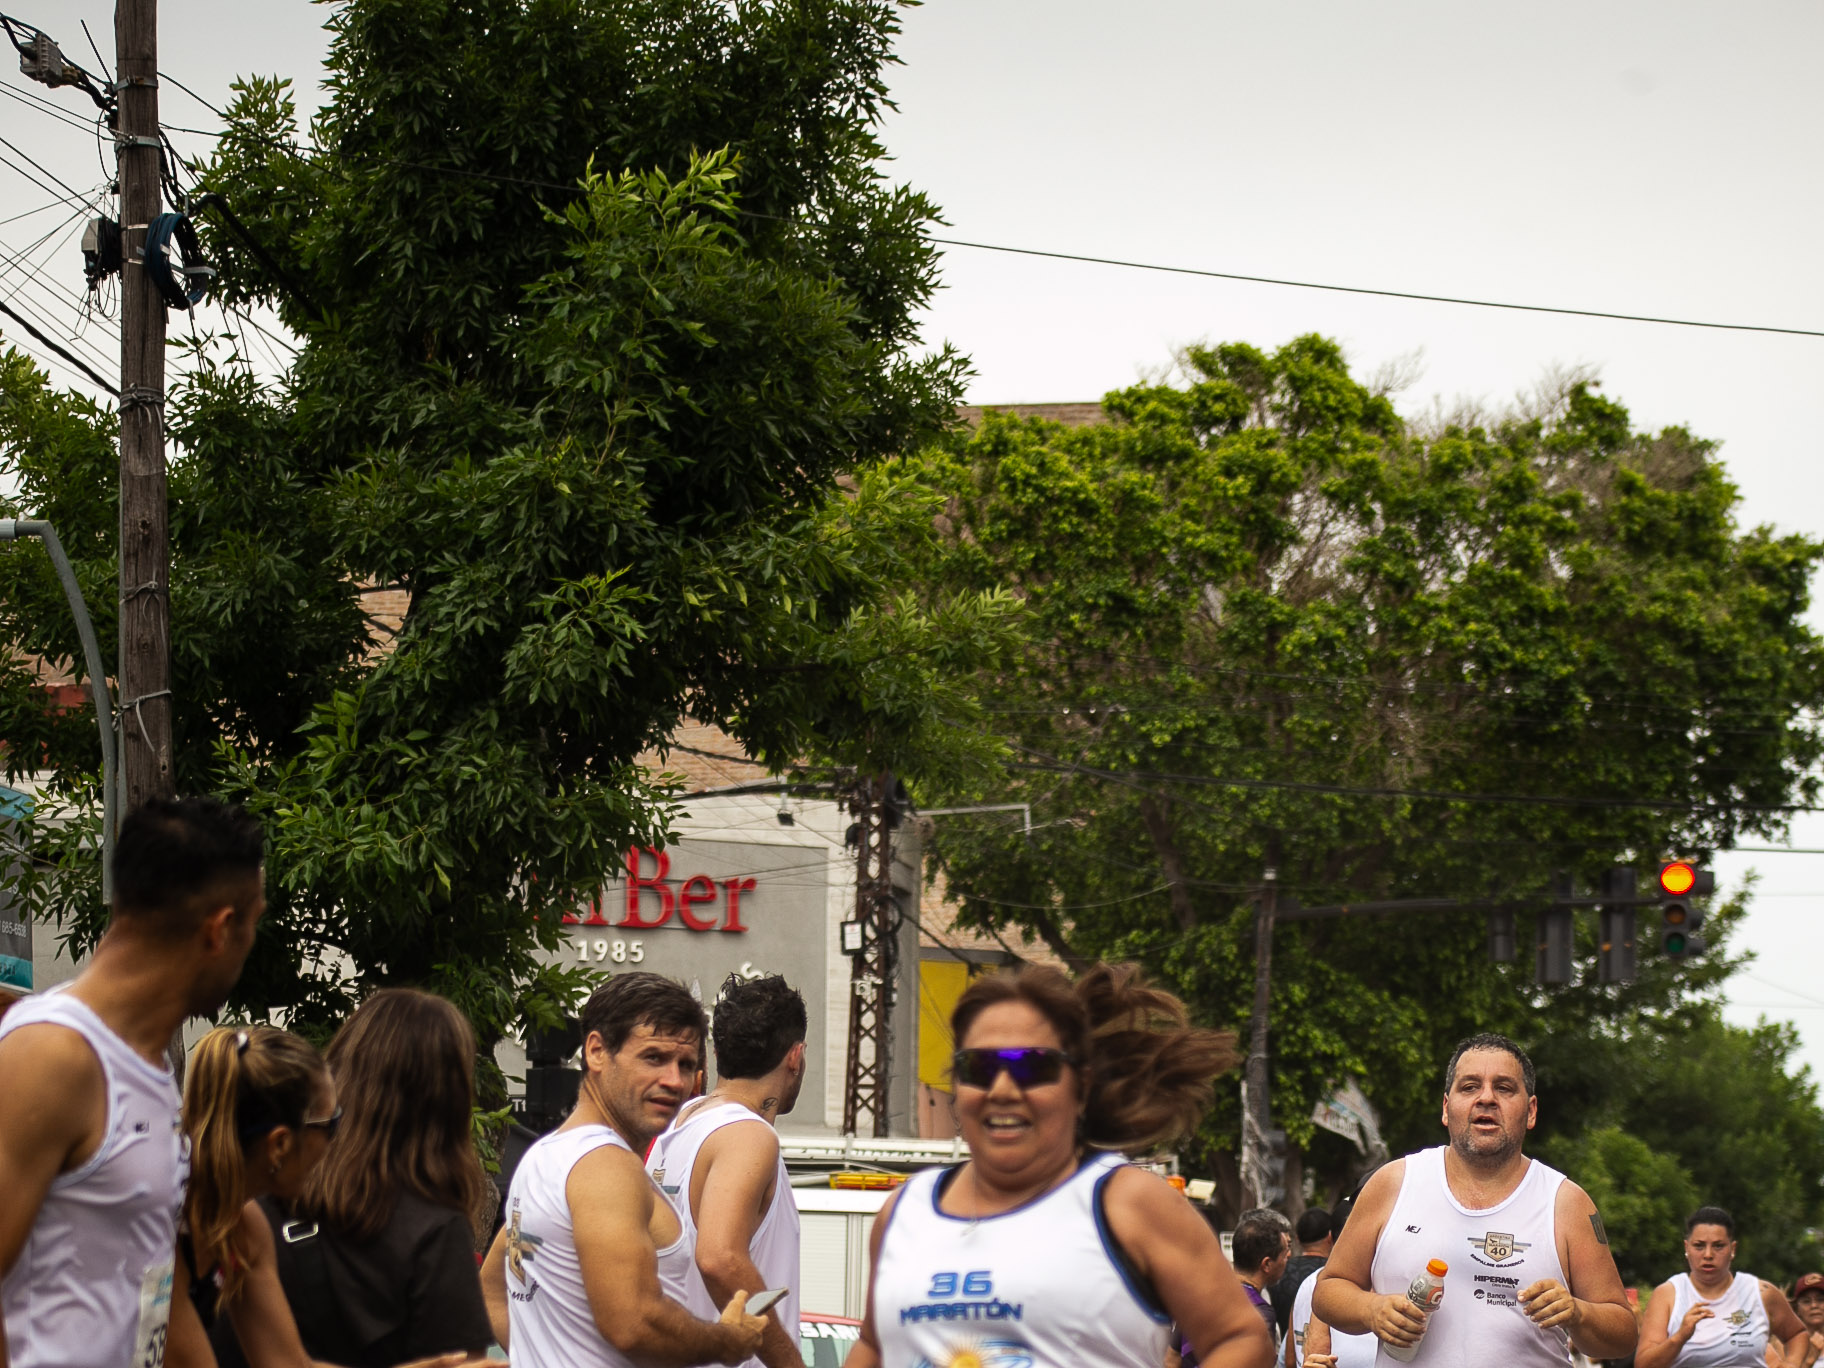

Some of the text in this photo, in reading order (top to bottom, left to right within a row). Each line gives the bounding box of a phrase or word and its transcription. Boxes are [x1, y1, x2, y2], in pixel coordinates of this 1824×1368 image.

[576, 938, 645, 963] 1985
[1490, 1247, 1507, 1256] 40
[1470, 1253, 1525, 1268] EMPALME GRANEROS
[928, 1270, 993, 1297] 36
[1486, 1299, 1517, 1307] Municipal
